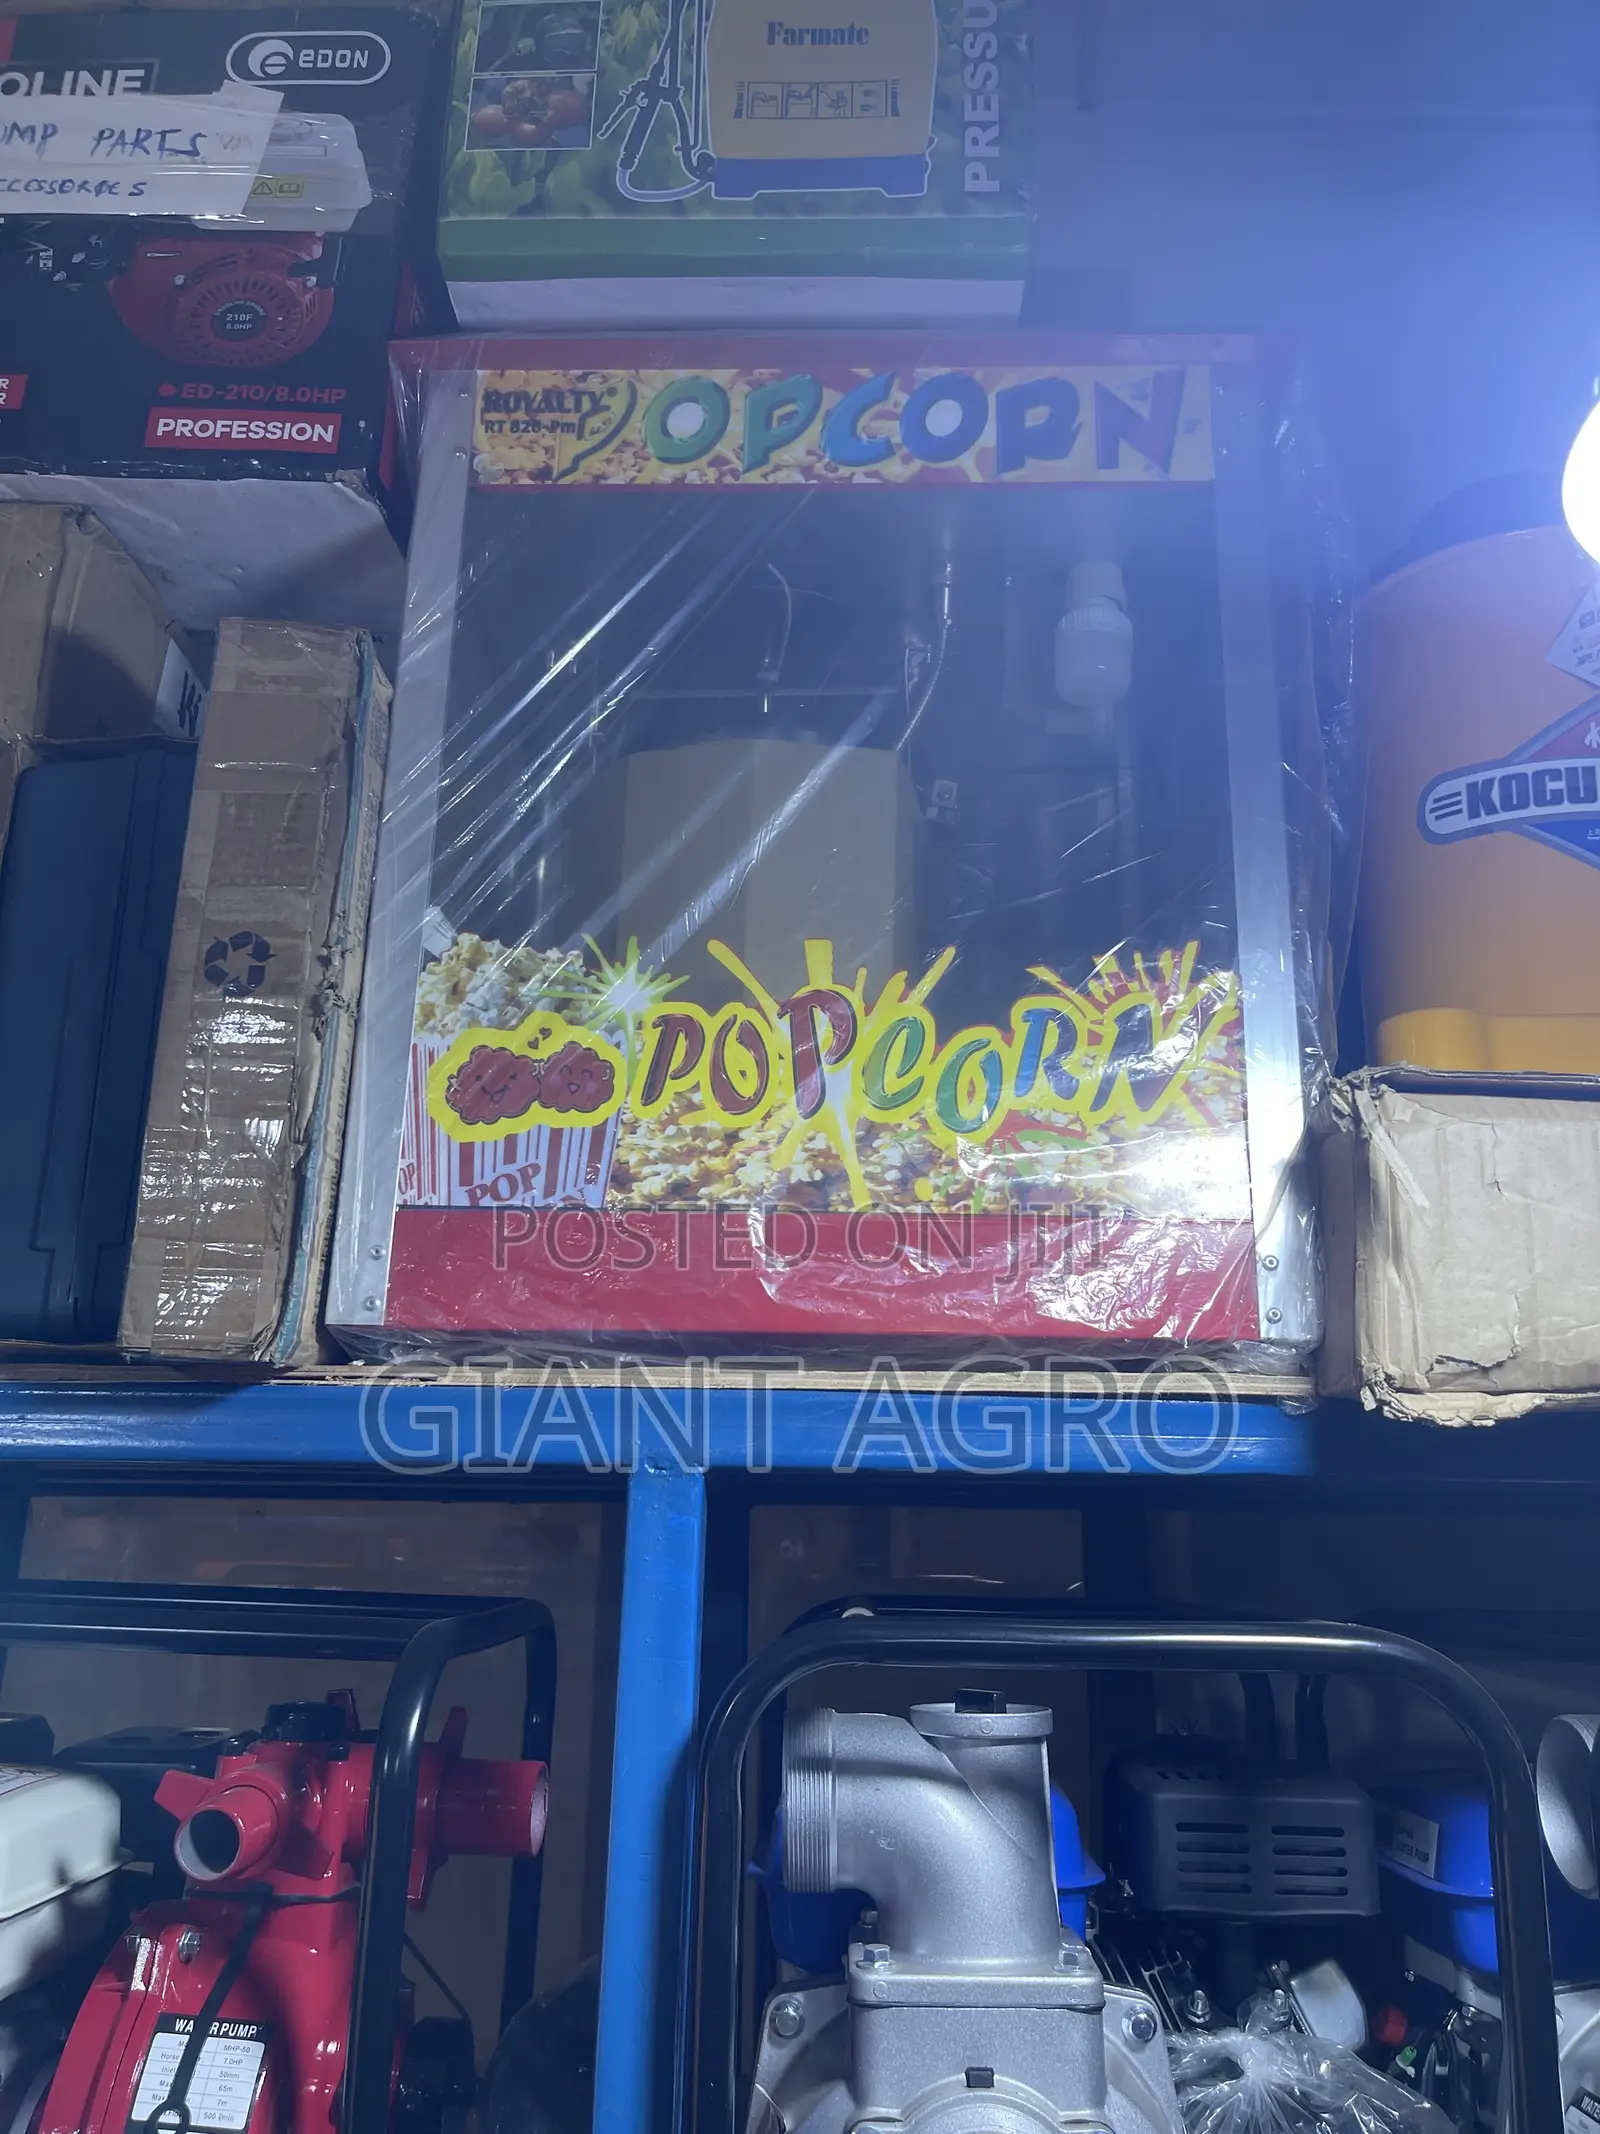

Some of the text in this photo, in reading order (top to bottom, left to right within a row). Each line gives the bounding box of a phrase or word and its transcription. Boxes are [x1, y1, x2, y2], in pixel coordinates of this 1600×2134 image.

[766, 21, 870, 46] Farmate
[963, 0, 1000, 192] PRESSU
[226, 313, 253, 321] 210F
[181, 382, 346, 404] ED-210/8.0HP
[156, 418, 334, 443] PROFESSION
[485, 420, 507, 433] RT
[1466, 765, 1598, 821] KOCU
[641, 972, 1236, 1134] POPCORN
[465, 1163, 542, 1207] POP
[175, 2018, 258, 2038] WAR PUMP
